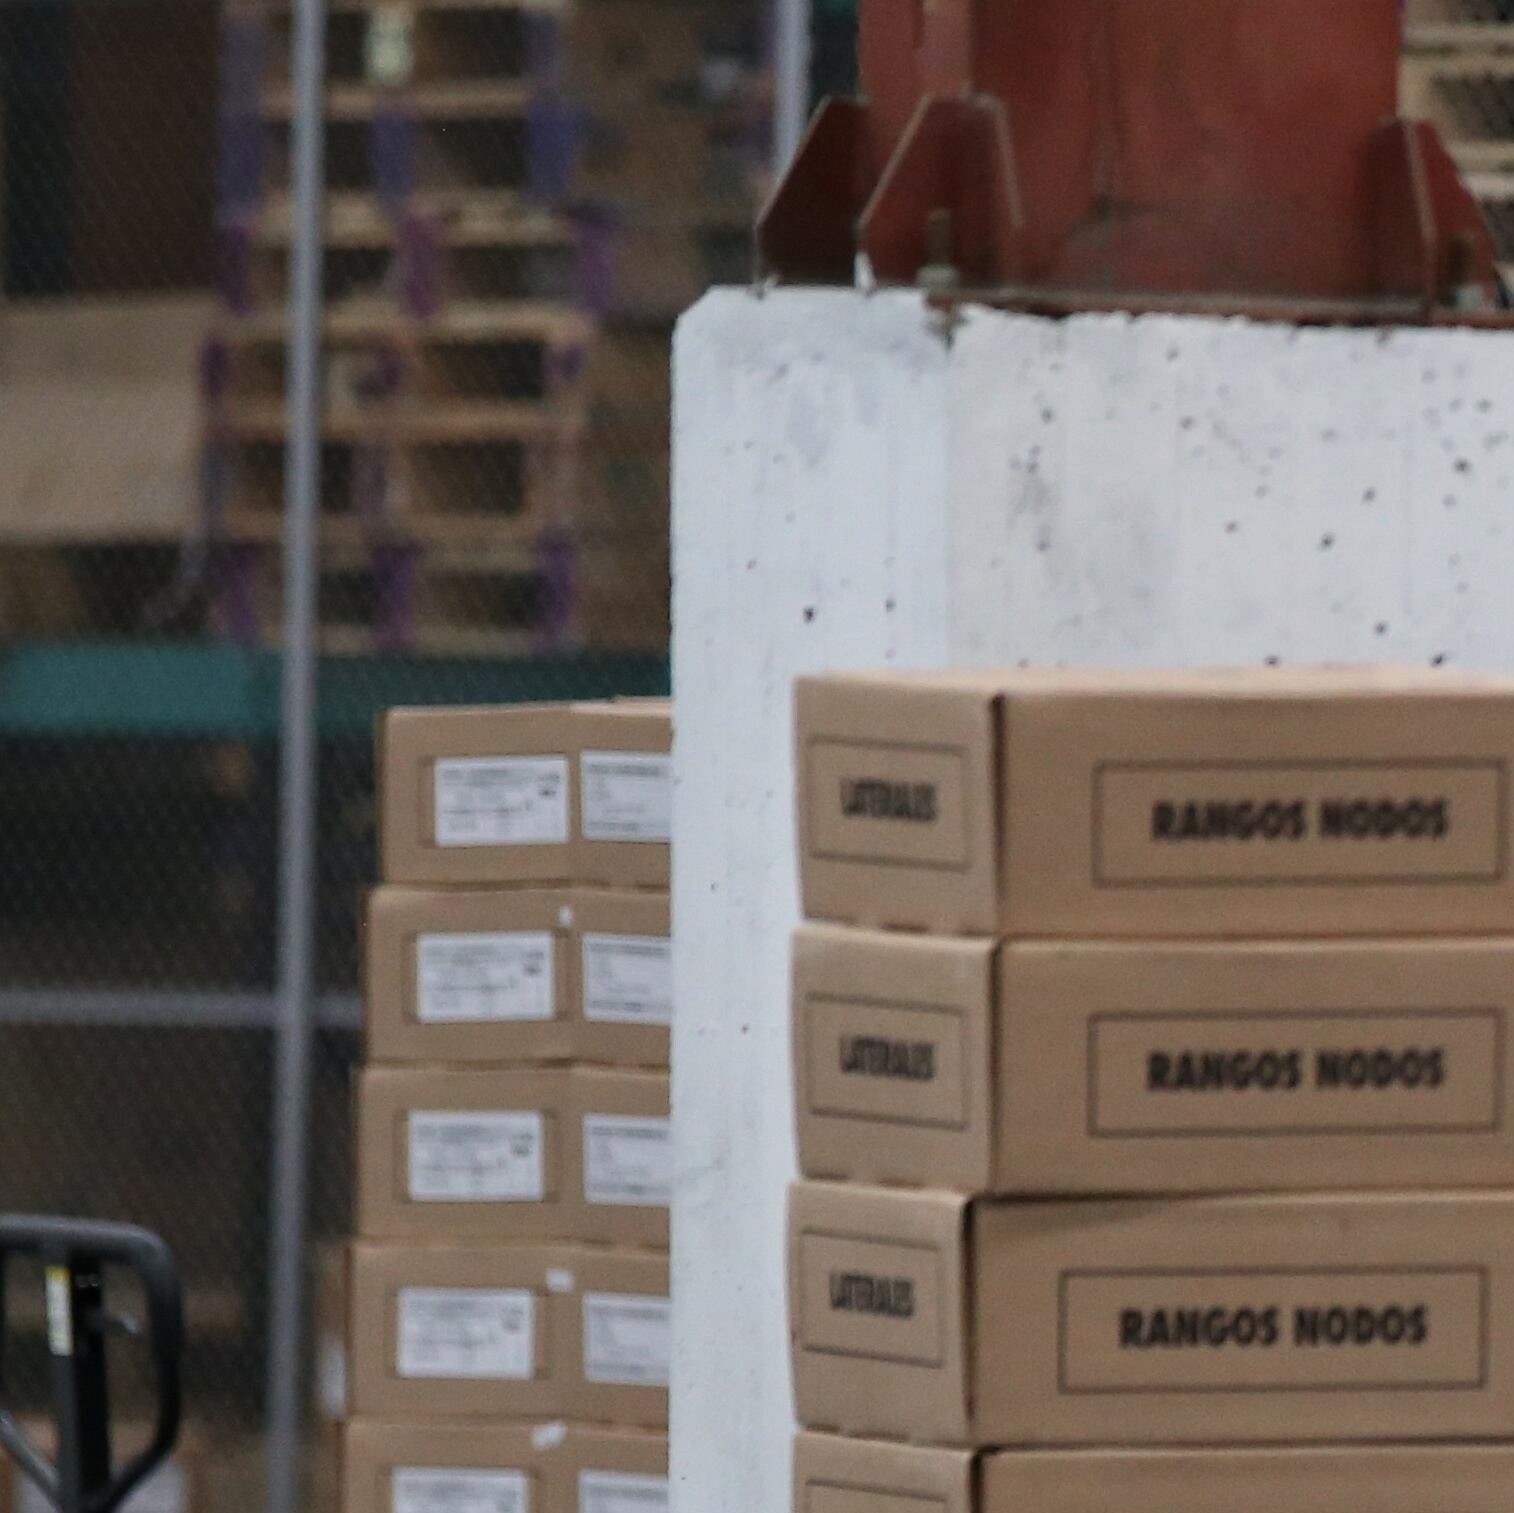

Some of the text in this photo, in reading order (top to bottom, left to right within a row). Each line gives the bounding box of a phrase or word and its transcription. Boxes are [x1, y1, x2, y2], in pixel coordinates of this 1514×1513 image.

[842, 777, 937, 823] LATERALES
[1151, 797, 1449, 843] RANGOS NODOS
[840, 1035, 935, 1081] LATERALES
[1146, 1046, 1446, 1093] RANGOS NODOS
[830, 1272, 915, 1319] LATERALES
[1118, 1304, 1428, 1349] RANGOS NODOS
